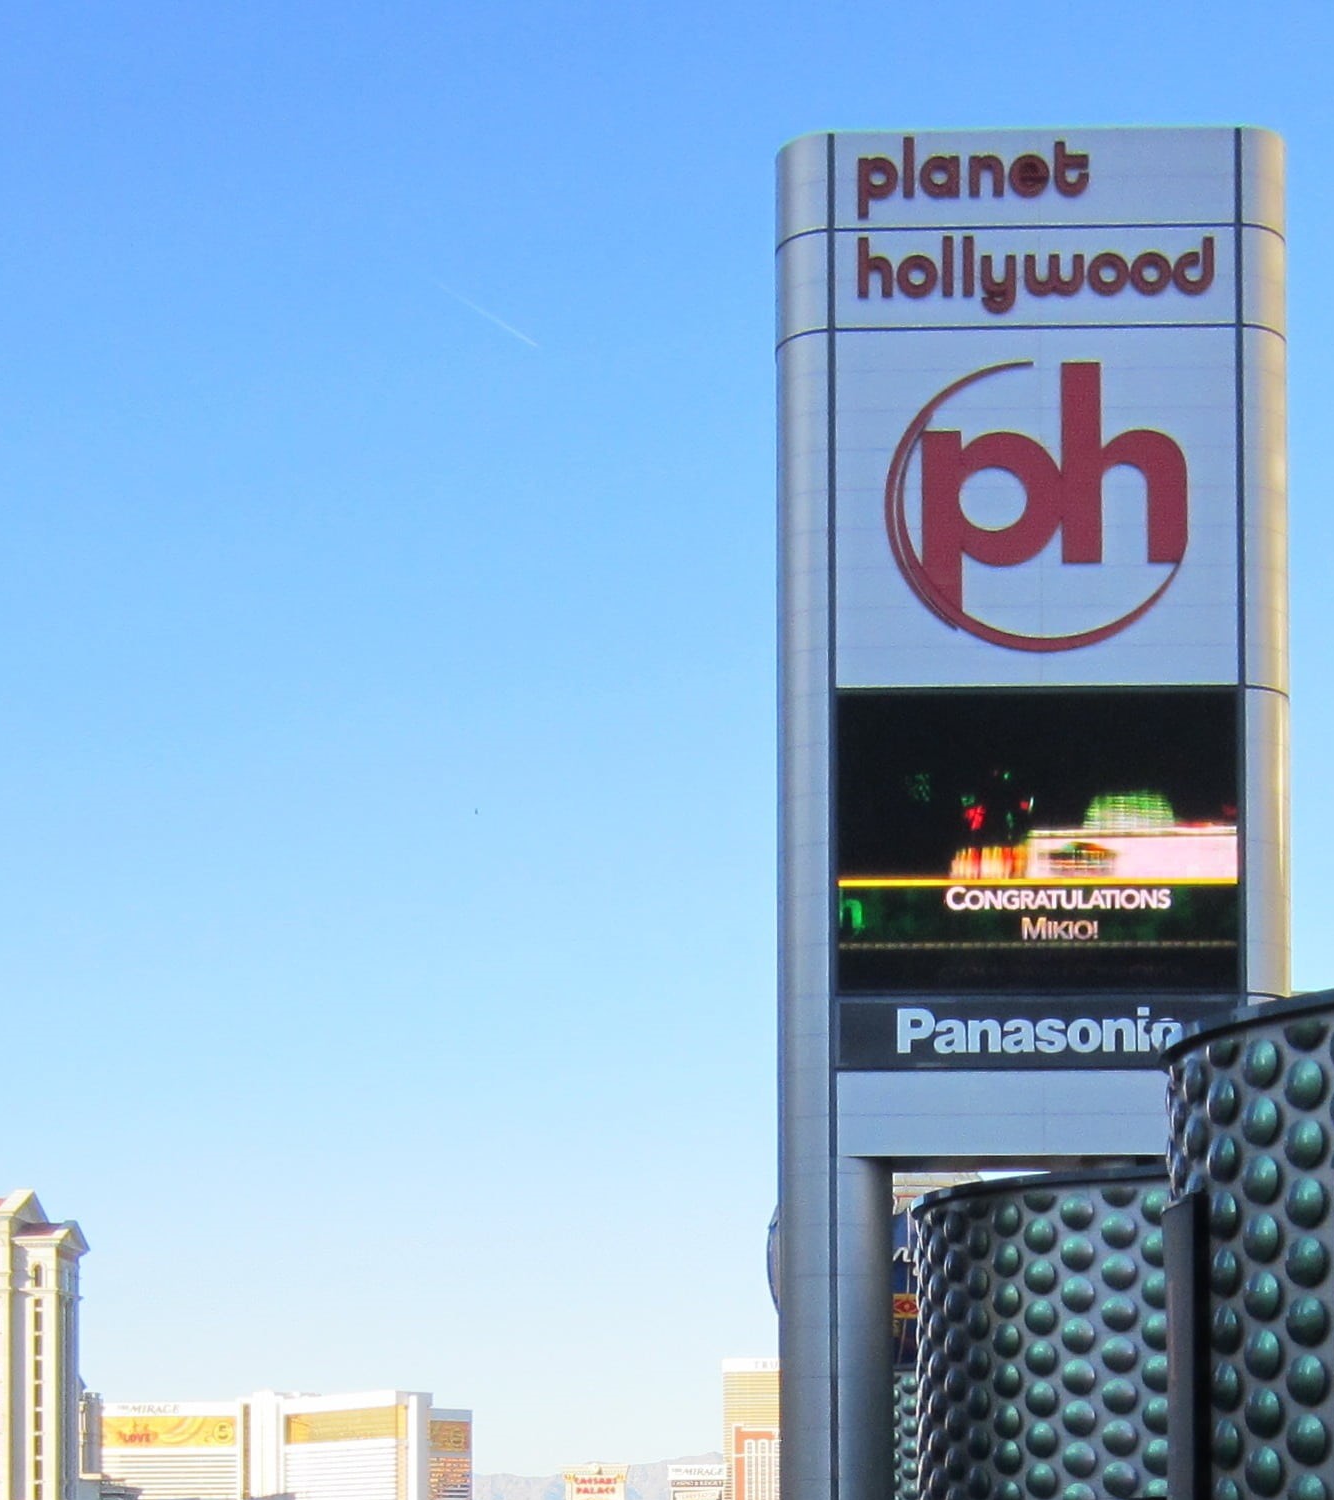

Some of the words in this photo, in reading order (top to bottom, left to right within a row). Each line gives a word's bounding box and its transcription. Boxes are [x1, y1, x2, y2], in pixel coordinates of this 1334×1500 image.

[857, 136, 1090, 220] planet
[857, 235, 1215, 315] hollywood
[921, 361, 1189, 616] ph
[945, 886, 1172, 912] CONGRATULATIONS
[1020, 917, 1099, 941] MIKIO!
[896, 1007, 1184, 1055] Panasonic
[130, 1404, 180, 1415] MIRAGE
[683, 1468, 724, 1476] MIRAGE
